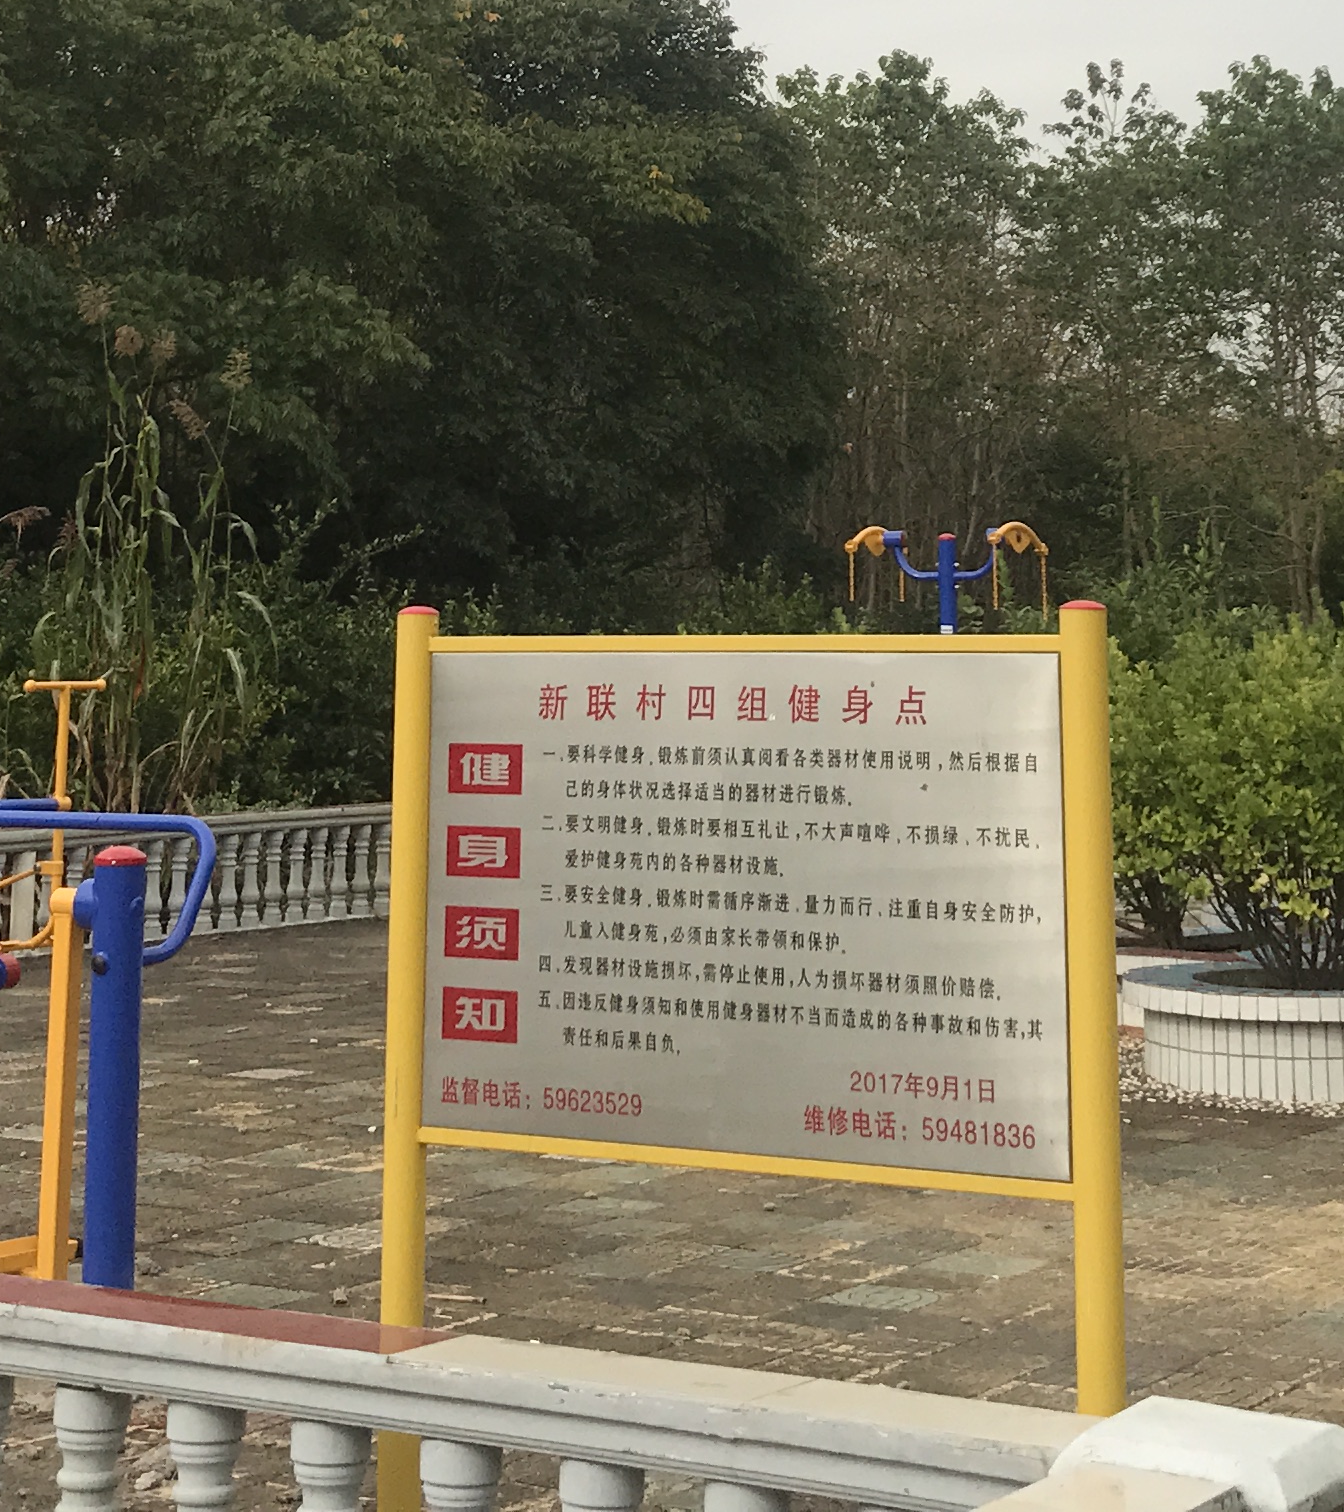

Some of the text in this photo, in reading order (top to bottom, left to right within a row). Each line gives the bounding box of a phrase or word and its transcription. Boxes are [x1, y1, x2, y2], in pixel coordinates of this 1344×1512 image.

[538, 683, 929, 726] 新联村四组健身点
[849, 1070, 996, 1105] 2017年9月1日
